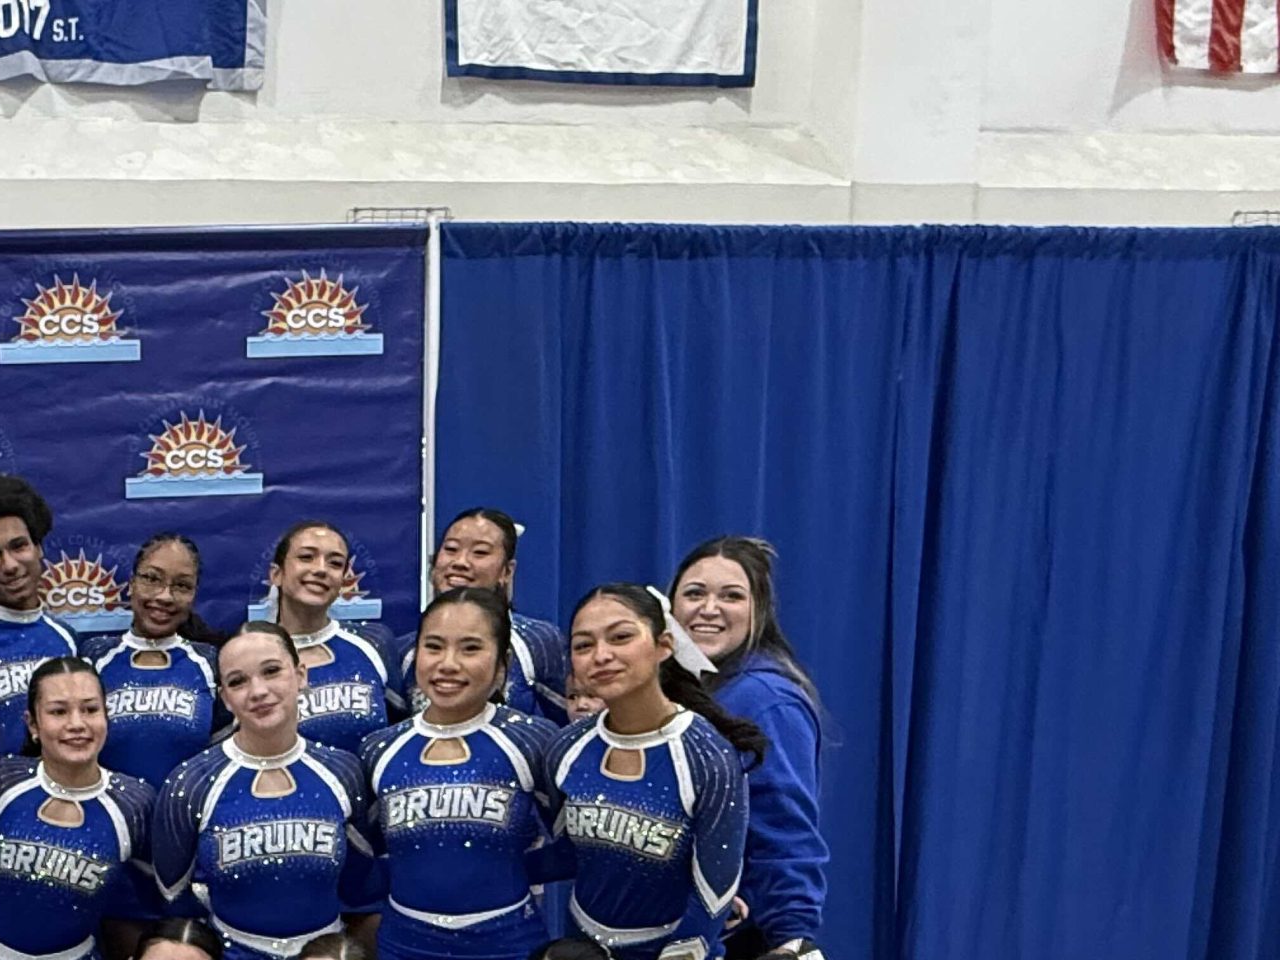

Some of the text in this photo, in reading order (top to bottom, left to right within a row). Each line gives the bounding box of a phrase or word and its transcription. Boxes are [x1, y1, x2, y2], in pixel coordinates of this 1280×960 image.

[52, 17, 84, 42] S.T.
[39, 313, 100, 336] CCS
[286, 307, 346, 329] CCS
[164, 449, 225, 471] CCS
[47, 586, 106, 607] CCS
[297, 686, 368, 720] RUINS
[389, 786, 509, 825] BRUINS
[221, 823, 336, 863] BRUINS
[565, 805, 678, 857] BRUINS
[0, 843, 107, 889] BRUINS
